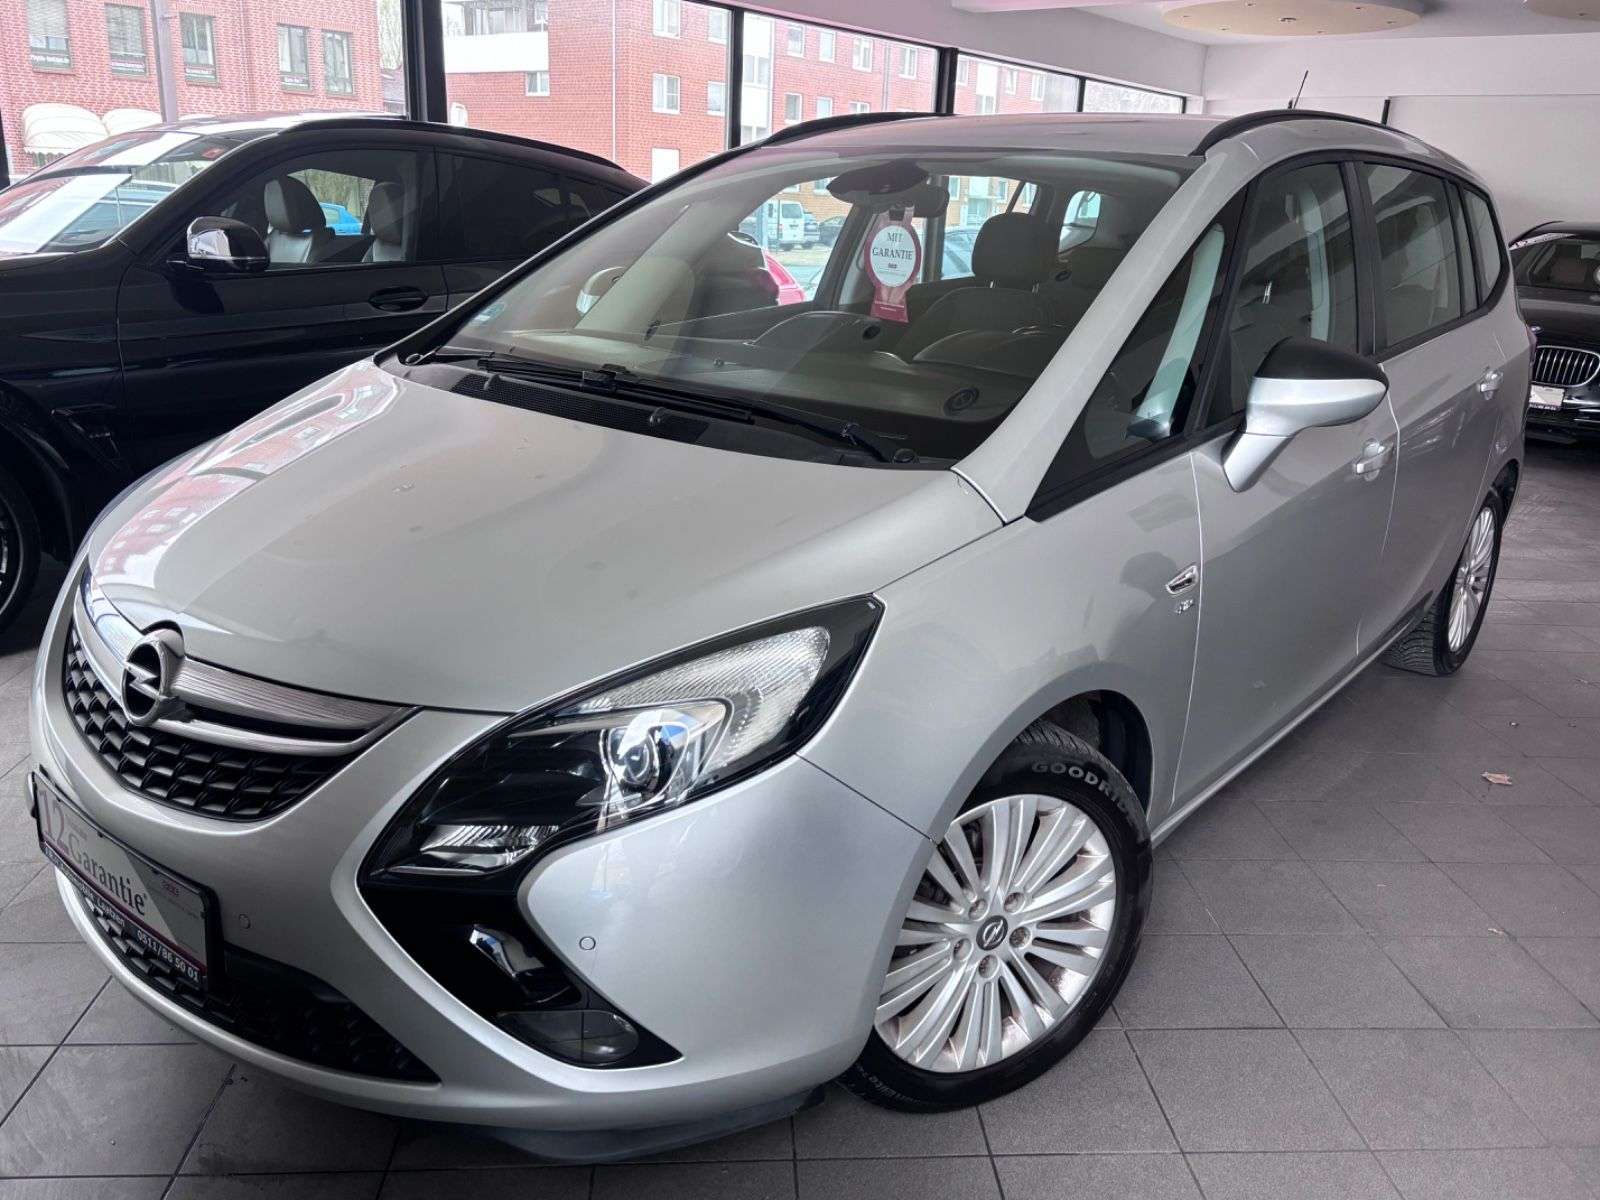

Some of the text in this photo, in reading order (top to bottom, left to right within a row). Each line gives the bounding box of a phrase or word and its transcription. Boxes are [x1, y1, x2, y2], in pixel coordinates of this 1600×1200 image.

[872, 247, 913, 260] GARANTIE
[887, 232, 902, 242] MIT
[39, 790, 69, 856] 12
[69, 832, 146, 916] Garantie
